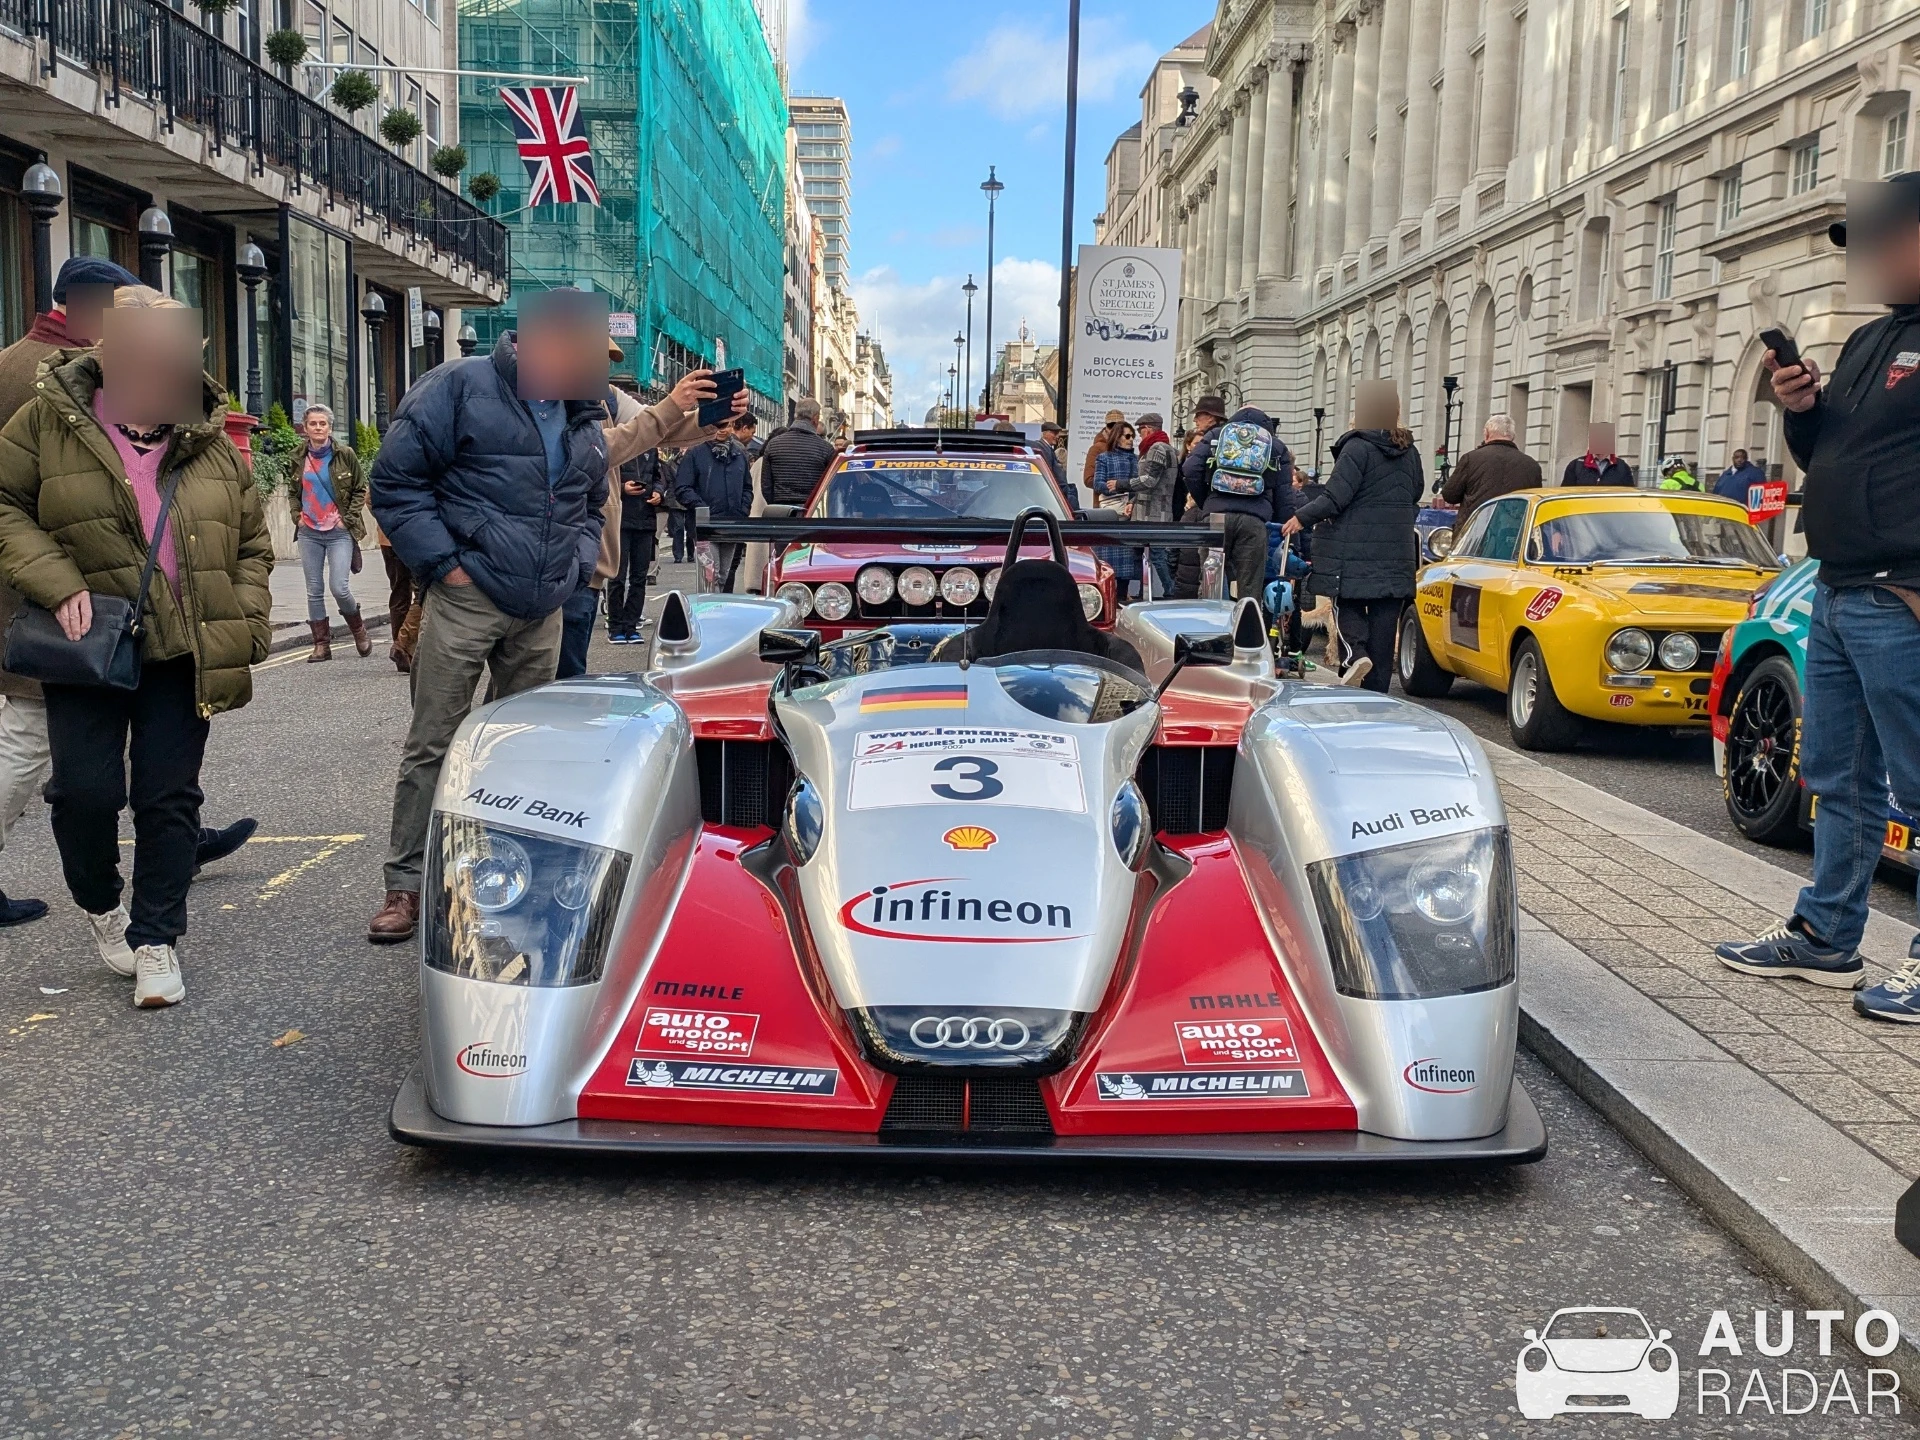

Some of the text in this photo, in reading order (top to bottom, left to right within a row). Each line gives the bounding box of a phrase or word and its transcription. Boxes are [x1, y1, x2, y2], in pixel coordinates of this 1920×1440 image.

[1102, 279, 1155, 290] ST JAMES'S
[1100, 289, 1156, 299] MOTORING
[1099, 300, 1155, 309] SPECTACLE
[1094, 357, 1145, 367] BICYCLES
[1083, 368, 1164, 380] MOTORCYCLES
[872, 460, 1006, 470] PromoService
[1765, 487, 1784, 497] wiper
[1762, 498, 1786, 511] blades
[1423, 602, 1443, 618] CORSE
[1528, 590, 1558, 616] Life
[1611, 695, 1633, 706] Life
[869, 728, 1066, 744] www.lemans.org
[909, 739, 956, 749] HEURES
[1788, 717, 1803, 782] EAGLE
[930, 756, 1004, 801] 3
[462, 788, 592, 828] Audi Bank
[1351, 802, 1475, 840] Audi Bank
[872, 886, 1072, 929] infineon
[653, 981, 745, 1000] MAHLE
[1188, 992, 1282, 1010] MAHLE
[648, 1012, 730, 1029] auto
[660, 1026, 743, 1042] motor
[1181, 1022, 1263, 1040] auto
[684, 1039, 749, 1052] sport
[1200, 1036, 1282, 1049] motor
[466, 1044, 527, 1068] infineon
[1230, 1047, 1295, 1060] sport
[680, 1067, 827, 1087] MICHELIN
[1412, 1060, 1476, 1082] infineon
[1150, 1075, 1294, 1091] MICHELIN
